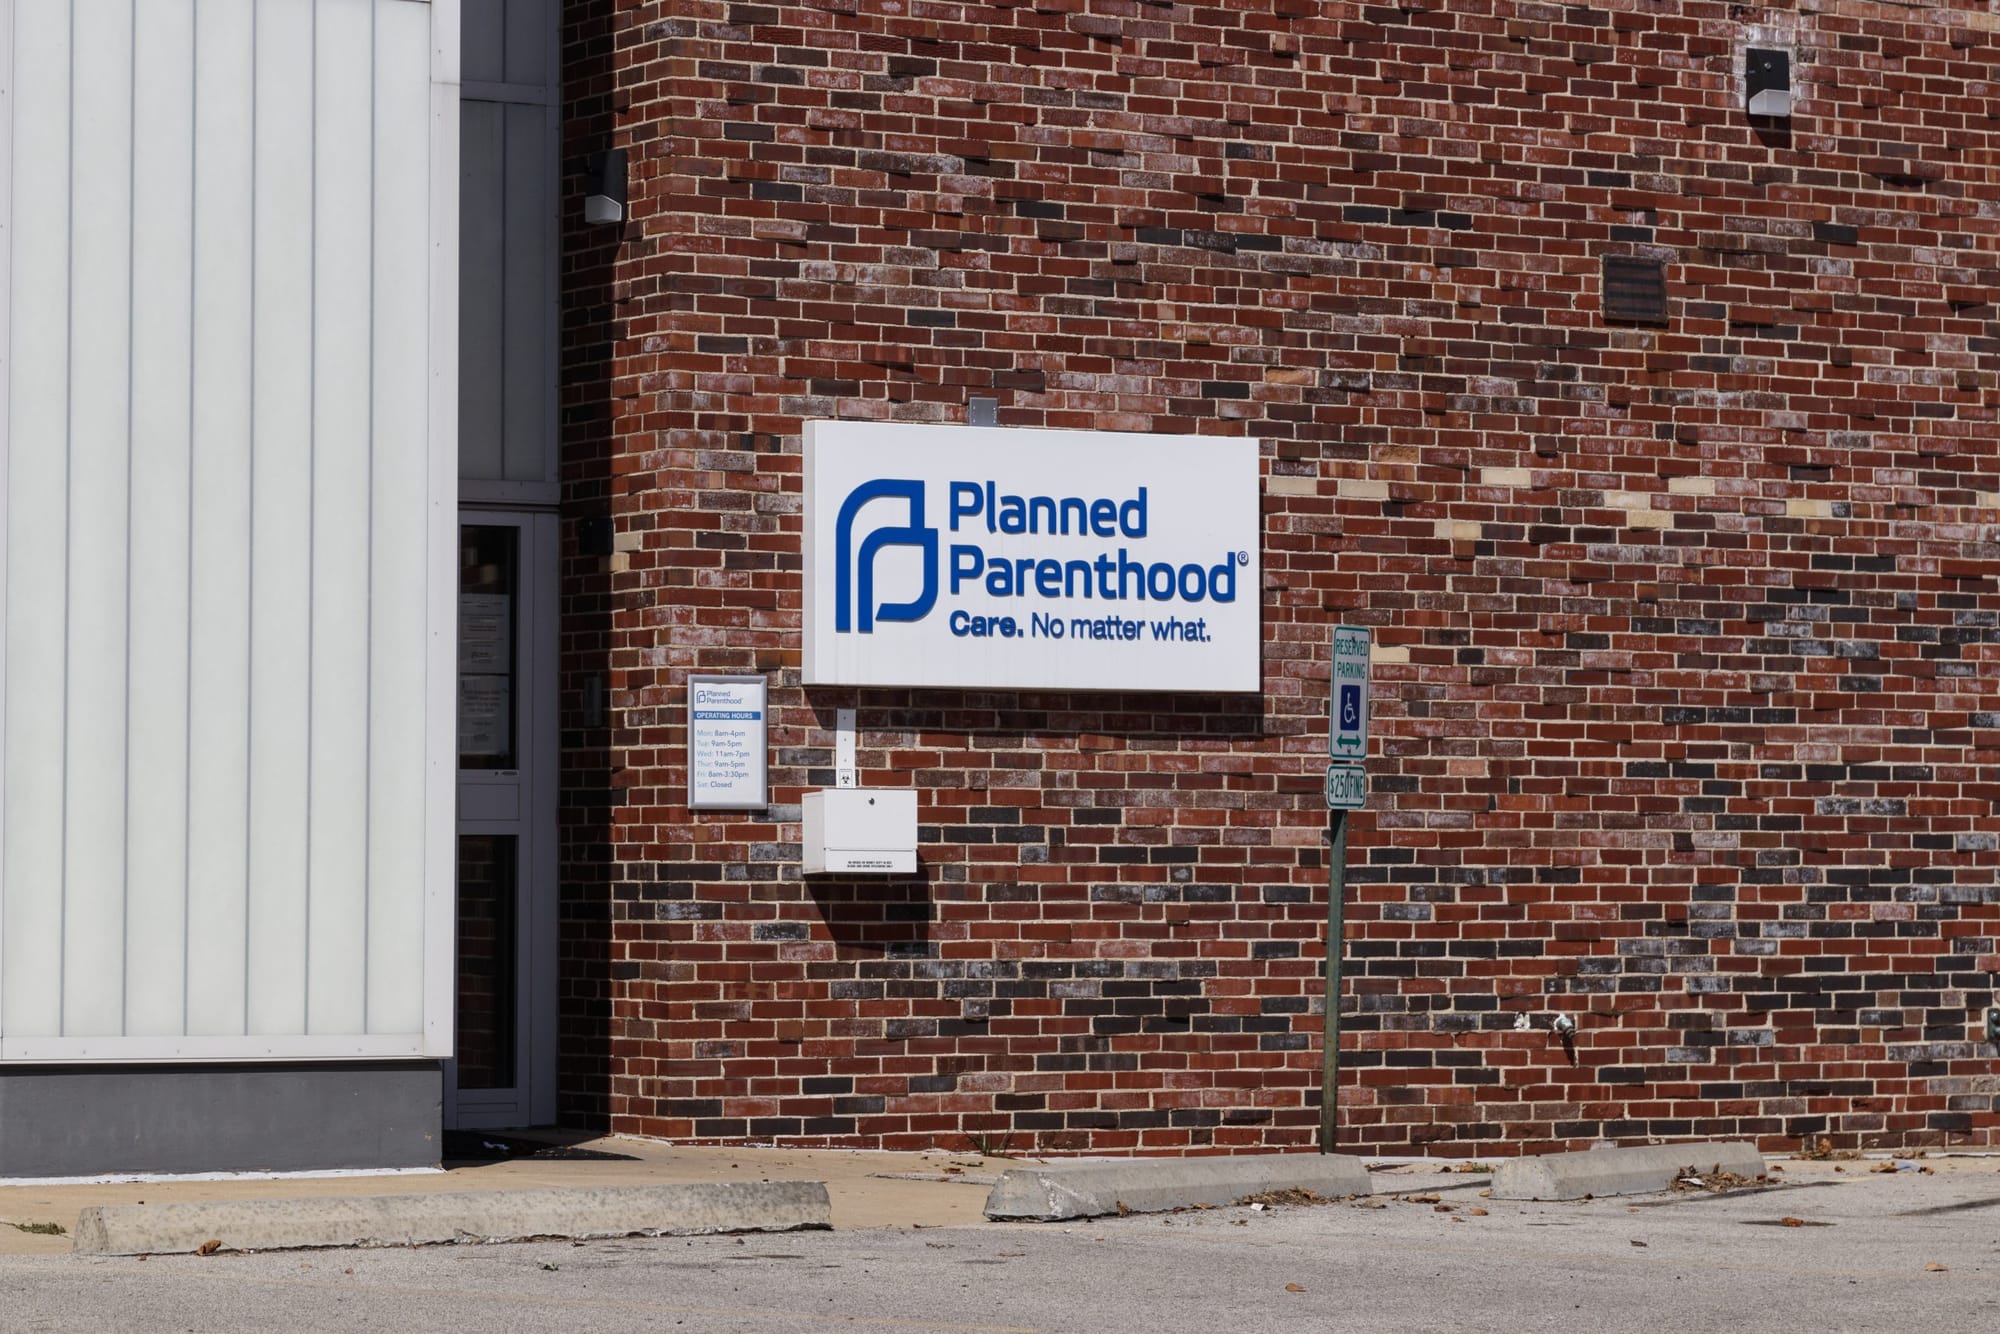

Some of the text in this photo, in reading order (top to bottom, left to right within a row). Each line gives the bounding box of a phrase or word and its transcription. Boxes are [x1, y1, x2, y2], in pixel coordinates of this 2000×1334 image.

[950, 480, 1147, 538] Planned
[949, 609, 1212, 642] Care. No matter what.
[1335, 638, 1368, 657] RESERVED
[1337, 661, 1366, 679] PARKING
